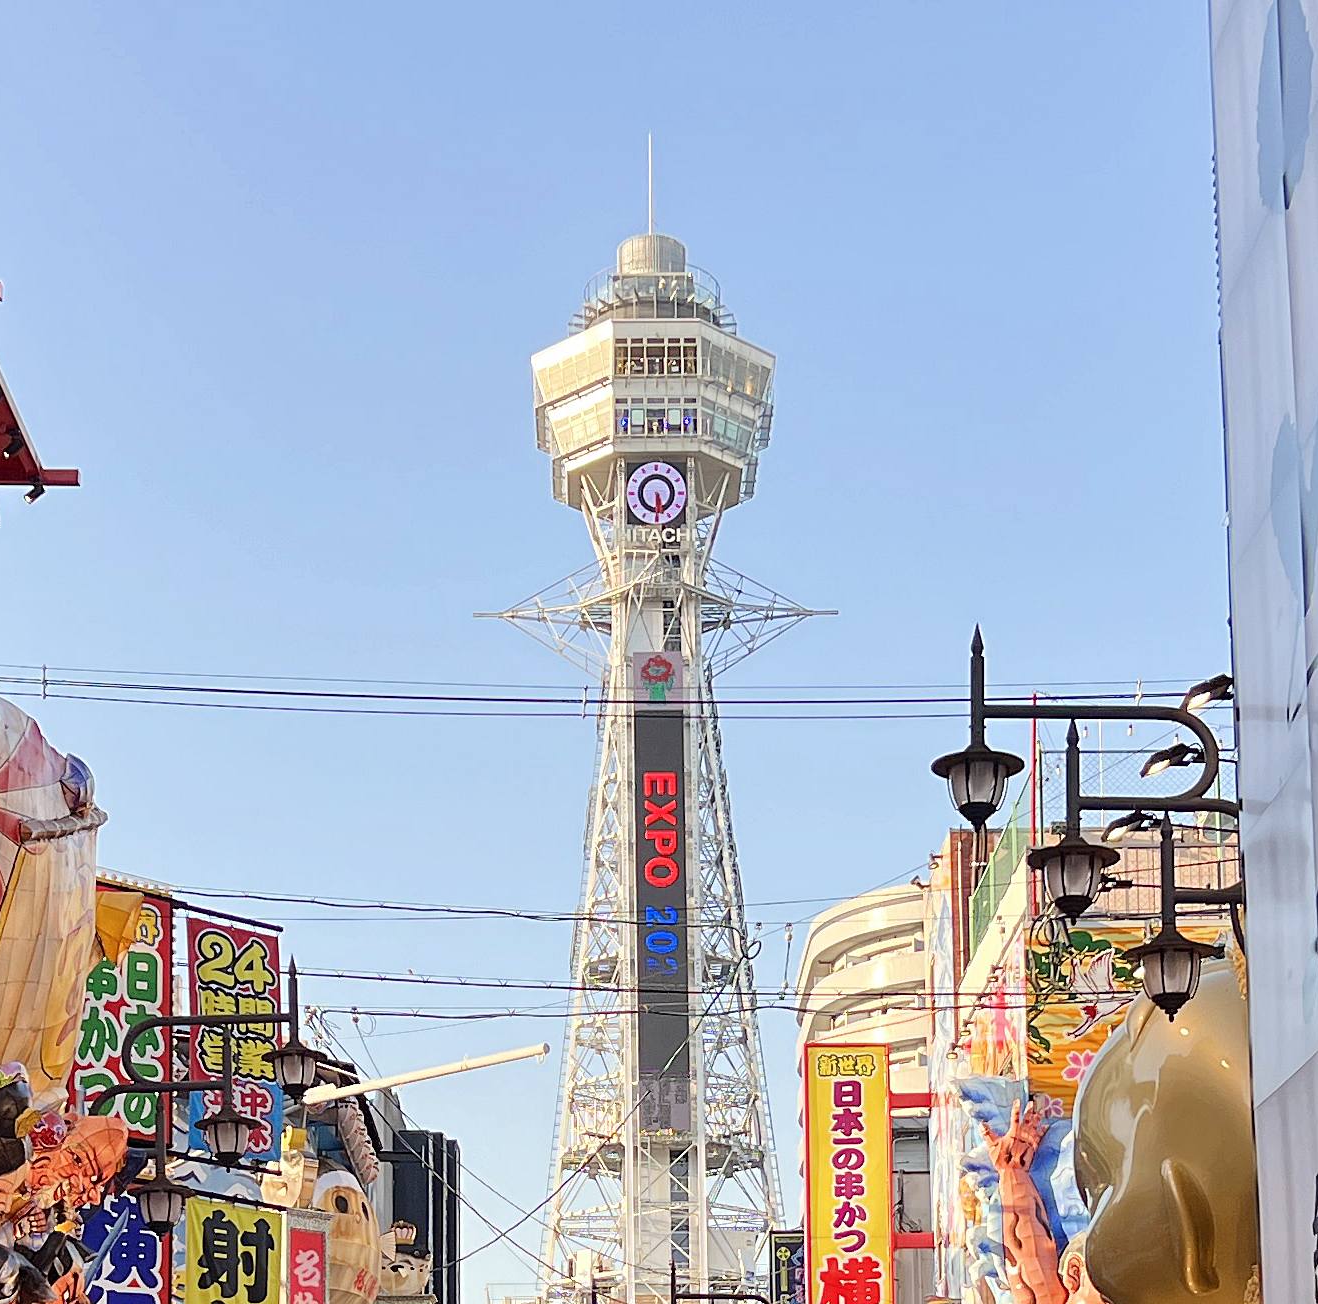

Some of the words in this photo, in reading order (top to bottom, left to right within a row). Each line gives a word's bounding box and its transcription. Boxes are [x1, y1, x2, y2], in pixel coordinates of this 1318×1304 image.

[643, 771, 679, 888] EXPO
[197, 931, 275, 994] 24
[818, 1054, 876, 1077] 新世界
[831, 1081, 867, 1253] 日本一の串かつ
